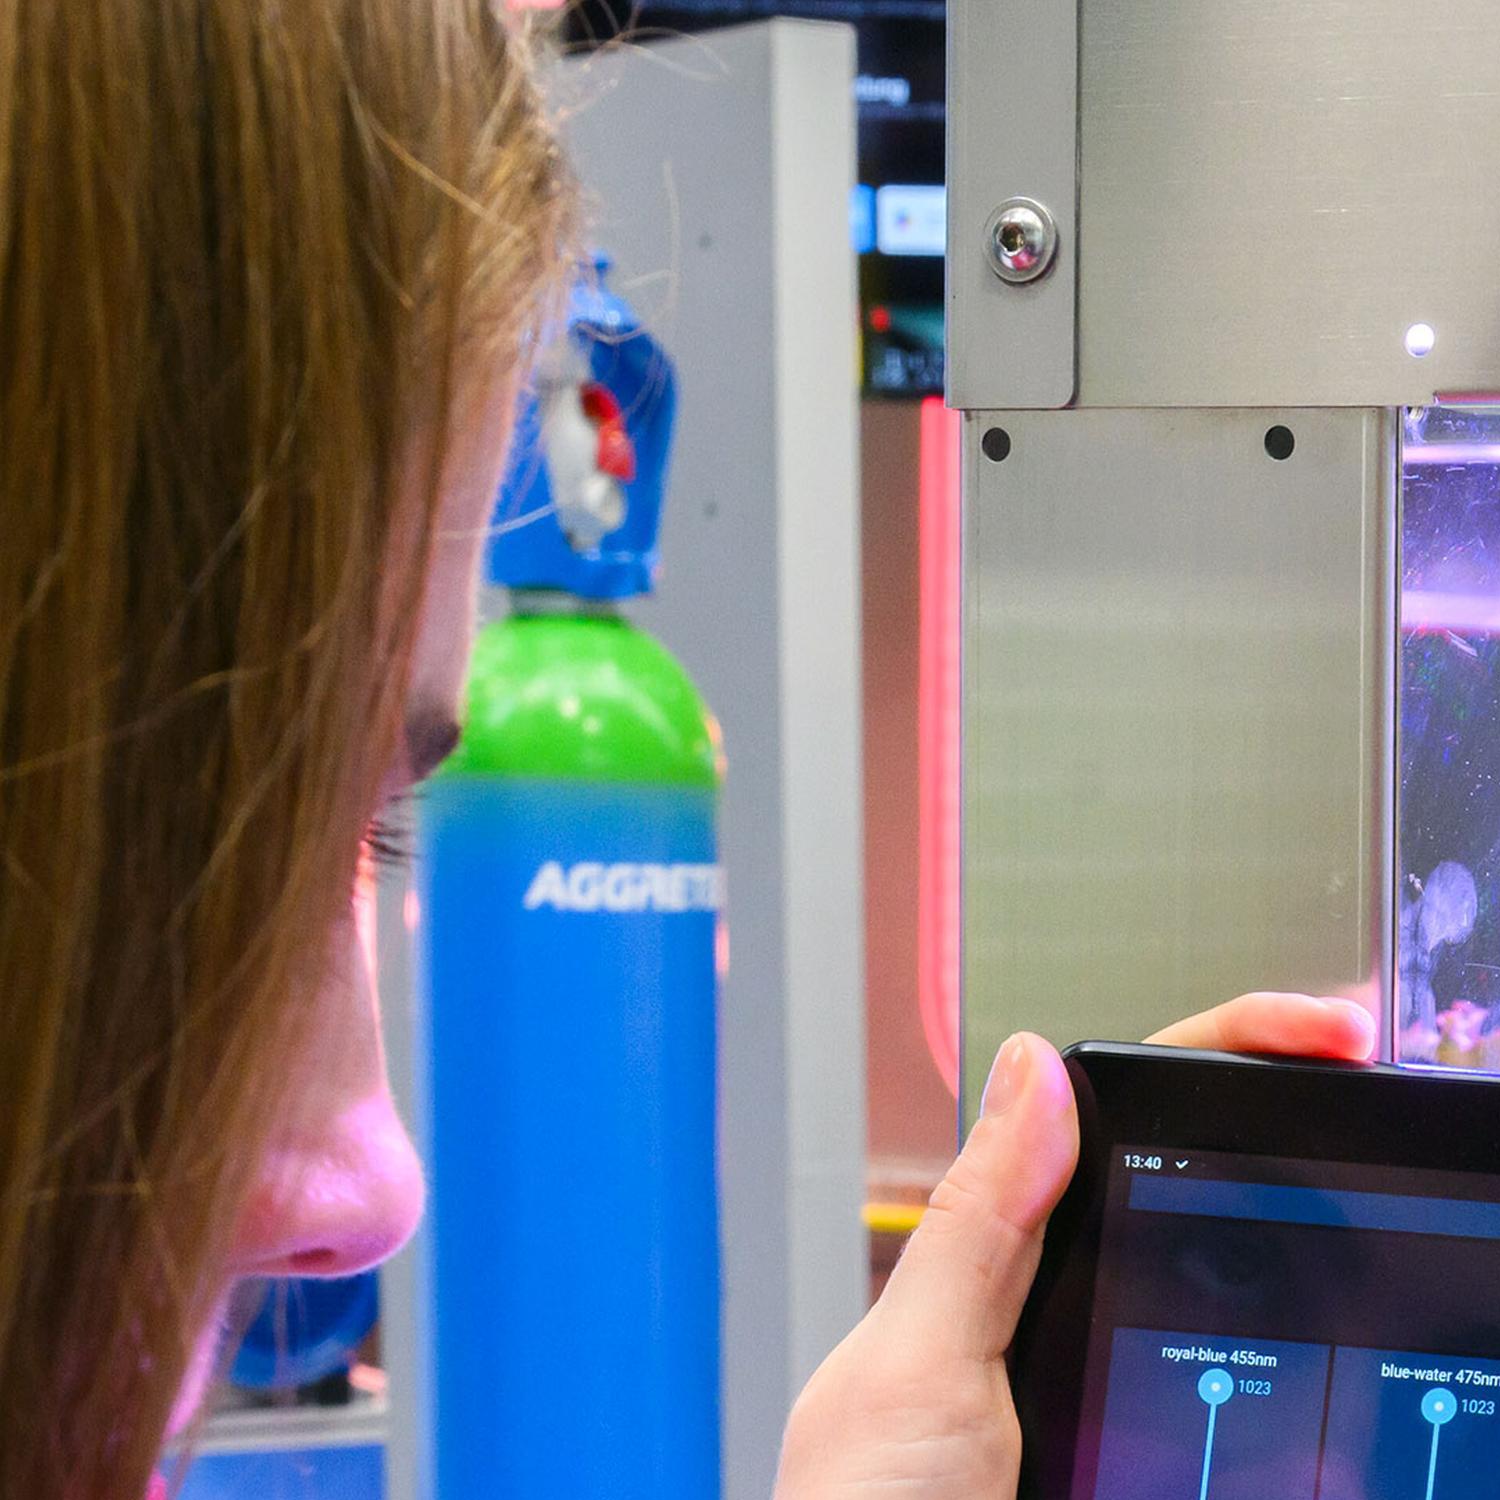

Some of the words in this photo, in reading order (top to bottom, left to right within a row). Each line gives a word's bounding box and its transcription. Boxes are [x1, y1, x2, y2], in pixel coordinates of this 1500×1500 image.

[1122, 1154, 1162, 1170] 13:40
[1161, 1346, 1228, 1363] royal-blue
[1229, 1349, 1278, 1368] 455nm
[1380, 1362, 1453, 1383] blue-water
[1238, 1379, 1272, 1396] 1023
[1461, 1398, 1496, 1416] 1023
